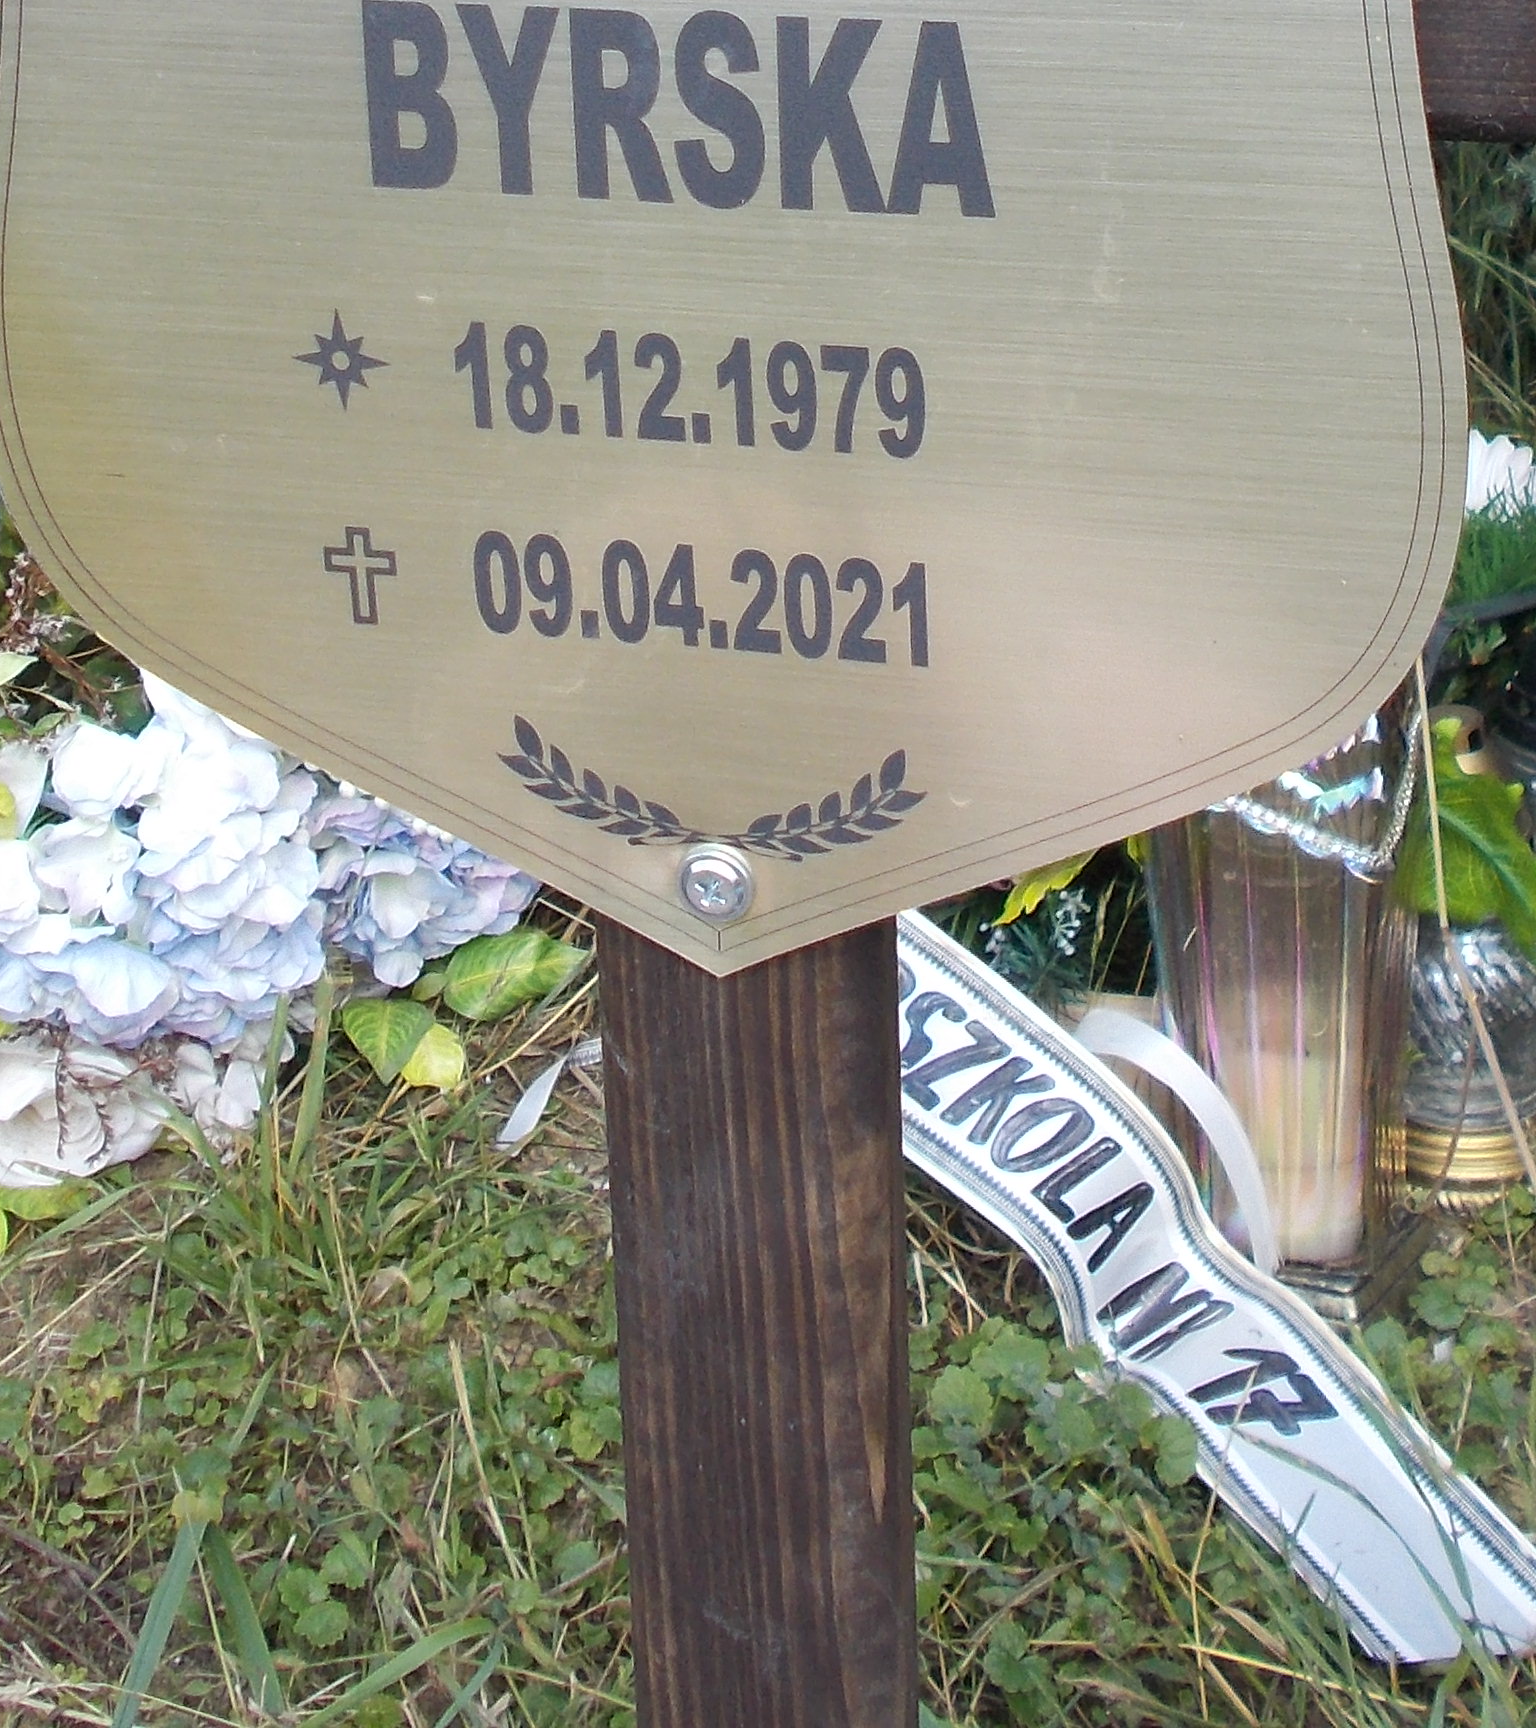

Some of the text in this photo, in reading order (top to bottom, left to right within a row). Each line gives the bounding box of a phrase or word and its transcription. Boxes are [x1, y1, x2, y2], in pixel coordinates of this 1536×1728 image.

[361, 0, 996, 218] BYRSKA
[454, 321, 927, 458] 18.12.1979
[473, 530, 930, 667] 09.04.2021
[900, 958, 1155, 1274] SZKOLA
[1186, 1348, 1339, 1435] 17
